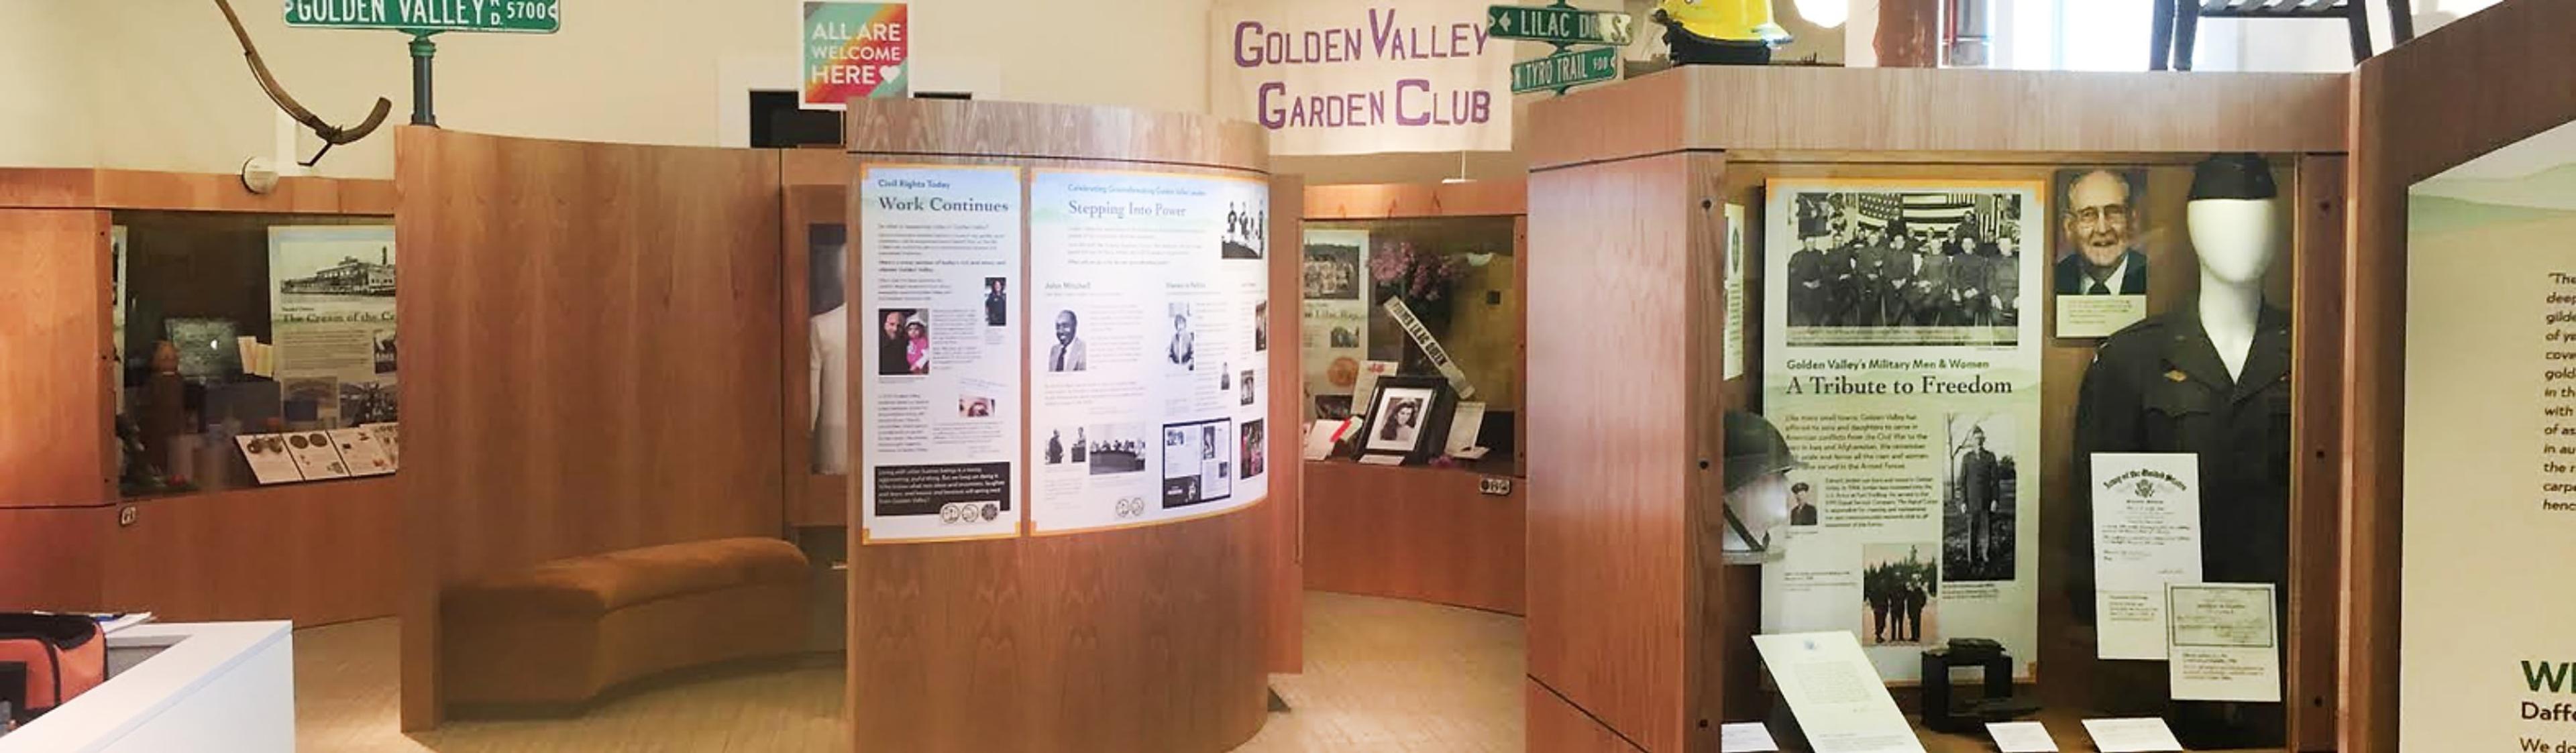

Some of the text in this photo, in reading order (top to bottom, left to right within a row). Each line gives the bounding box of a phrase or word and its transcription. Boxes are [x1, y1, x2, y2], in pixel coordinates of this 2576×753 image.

[297, 0, 386, 23] GOLDEN
[401, 0, 483, 25] VALLEY
[506, 4, 546, 20] 5700
[1521, 10, 1570, 37] LILAC
[812, 22, 901, 42] ALL ARE
[1234, 9, 1488, 67] GOLDEN VALLEY
[812, 46, 901, 61] WELCOME
[812, 64, 876, 84] HERE
[1557, 54, 1588, 82] TRAIL
[1258, 79, 1490, 131] GARDEN CLUB
[878, 179, 950, 189] Civil Rights Today
[879, 196, 1009, 212] Work Continues
[1069, 200, 1186, 219] Stepping Into Power
[2546, 329, 2560, 340] of
[1786, 359, 1990, 371] Golden Valley's Military Men & Women
[1786, 374, 2012, 394] A Tribute to Freedom
[2544, 388, 2557, 397] in
[2544, 406, 2573, 416] with
[2544, 424, 2559, 435] of
[2544, 444, 2555, 454] in
[2544, 461, 2567, 473] the
[2520, 738, 2549, 752] We
